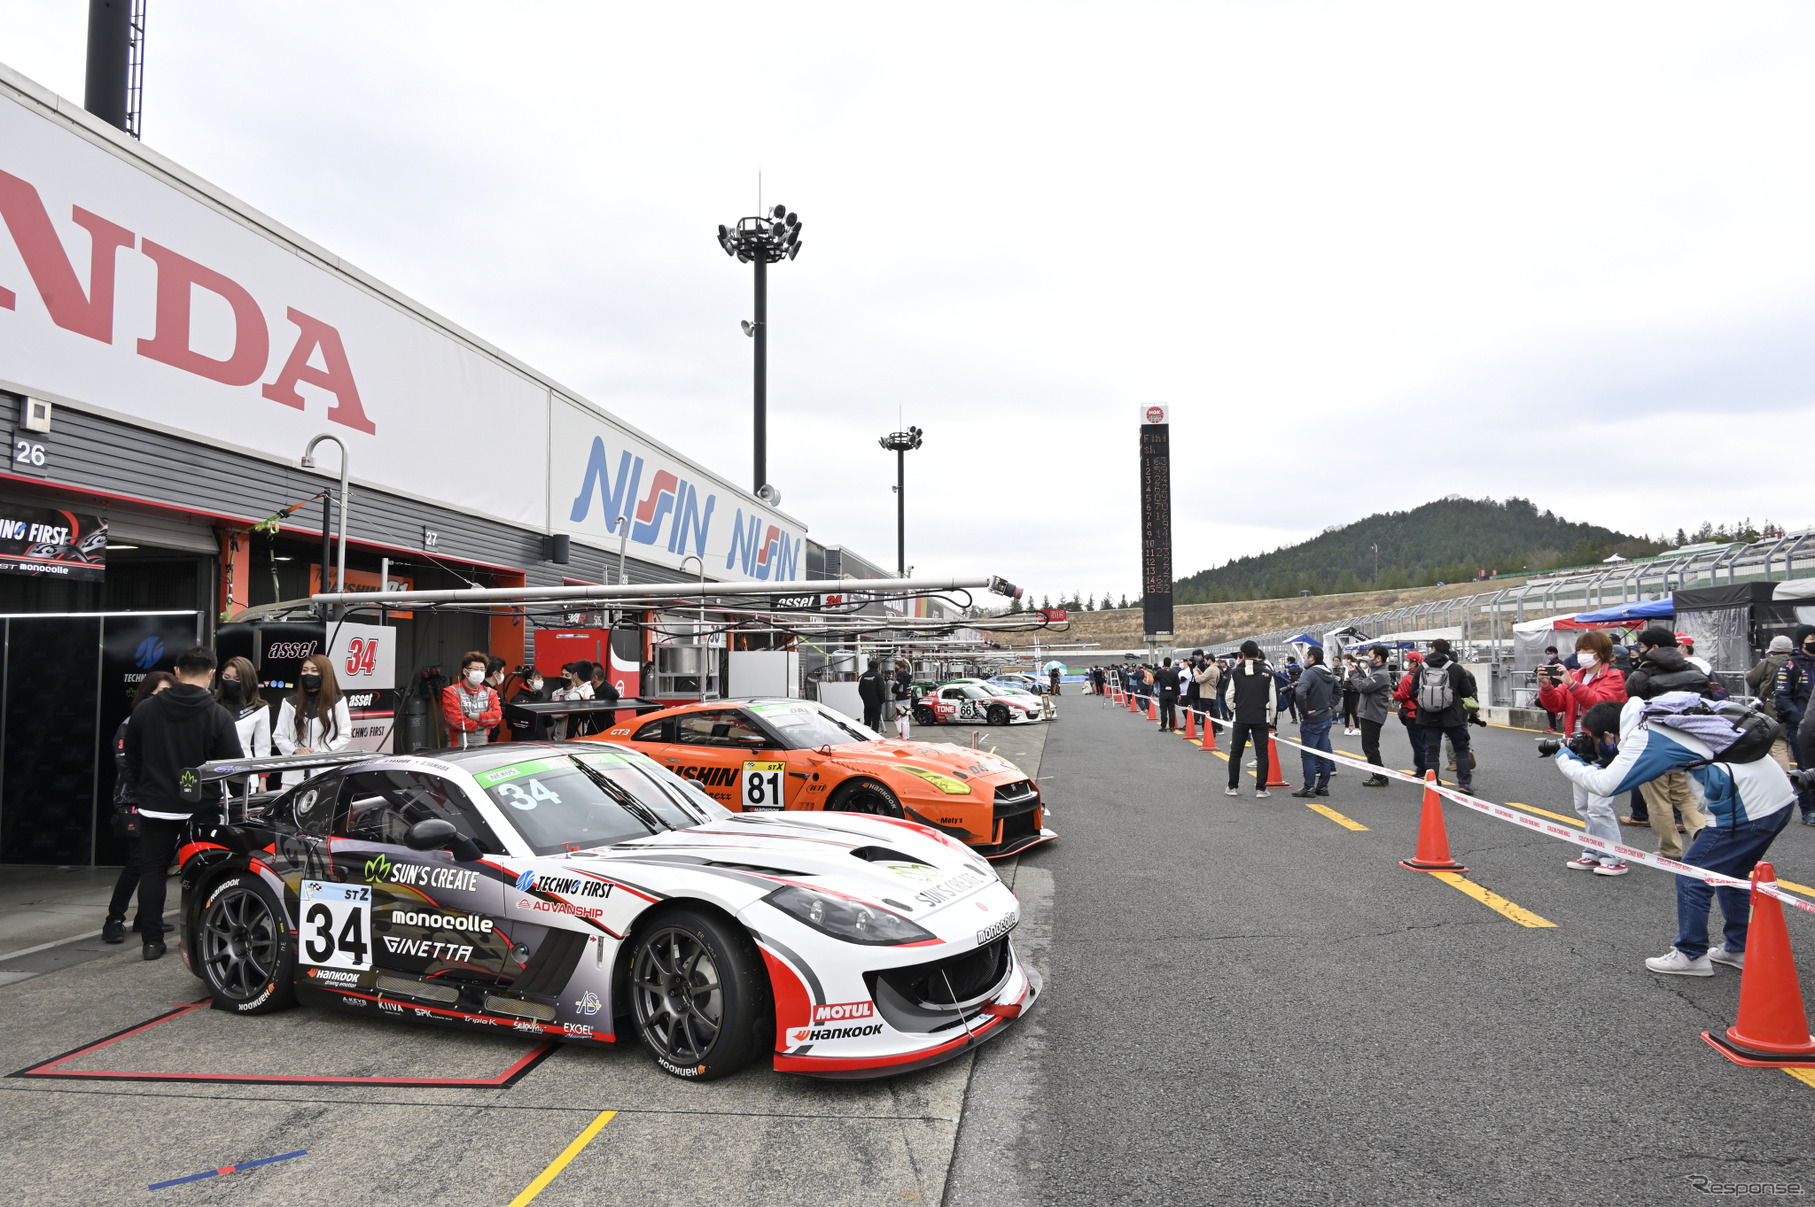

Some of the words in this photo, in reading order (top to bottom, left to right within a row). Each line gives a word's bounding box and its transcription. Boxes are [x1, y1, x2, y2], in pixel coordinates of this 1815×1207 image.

[17, 441, 45, 466] 26
[28, 523, 68, 545] FIRST
[426, 532, 438, 546] 27
[19, 563, 69, 574] monocolle
[268, 641, 317, 659] asset
[345, 636, 379, 676] 34
[124, 674, 147, 682] TECHN
[349, 693, 373, 707] asset
[937, 705, 955, 713] TONE
[961, 706, 971, 716] 66
[369, 726, 385, 737] FIRST
[611, 728, 630, 736] GT3
[497, 778, 562, 811] 34
[748, 772, 779, 805] 81
[390, 863, 431, 886] SUN'S
[431, 867, 480, 892] CREATE
[536, 876, 581, 895] TECHNO
[581, 881, 614, 899] FIRST
[533, 901, 603, 918] ADVANSHIP
[392, 911, 494, 934] monocolle
[305, 903, 368, 965] 34
[382, 935, 473, 963] GINETTA
[378, 1001, 404, 1013] KIIVA
[414, 1008, 433, 1018] SPK
[816, 1001, 871, 1020] MOTUL
[563, 1022, 592, 1035] EXGEL
